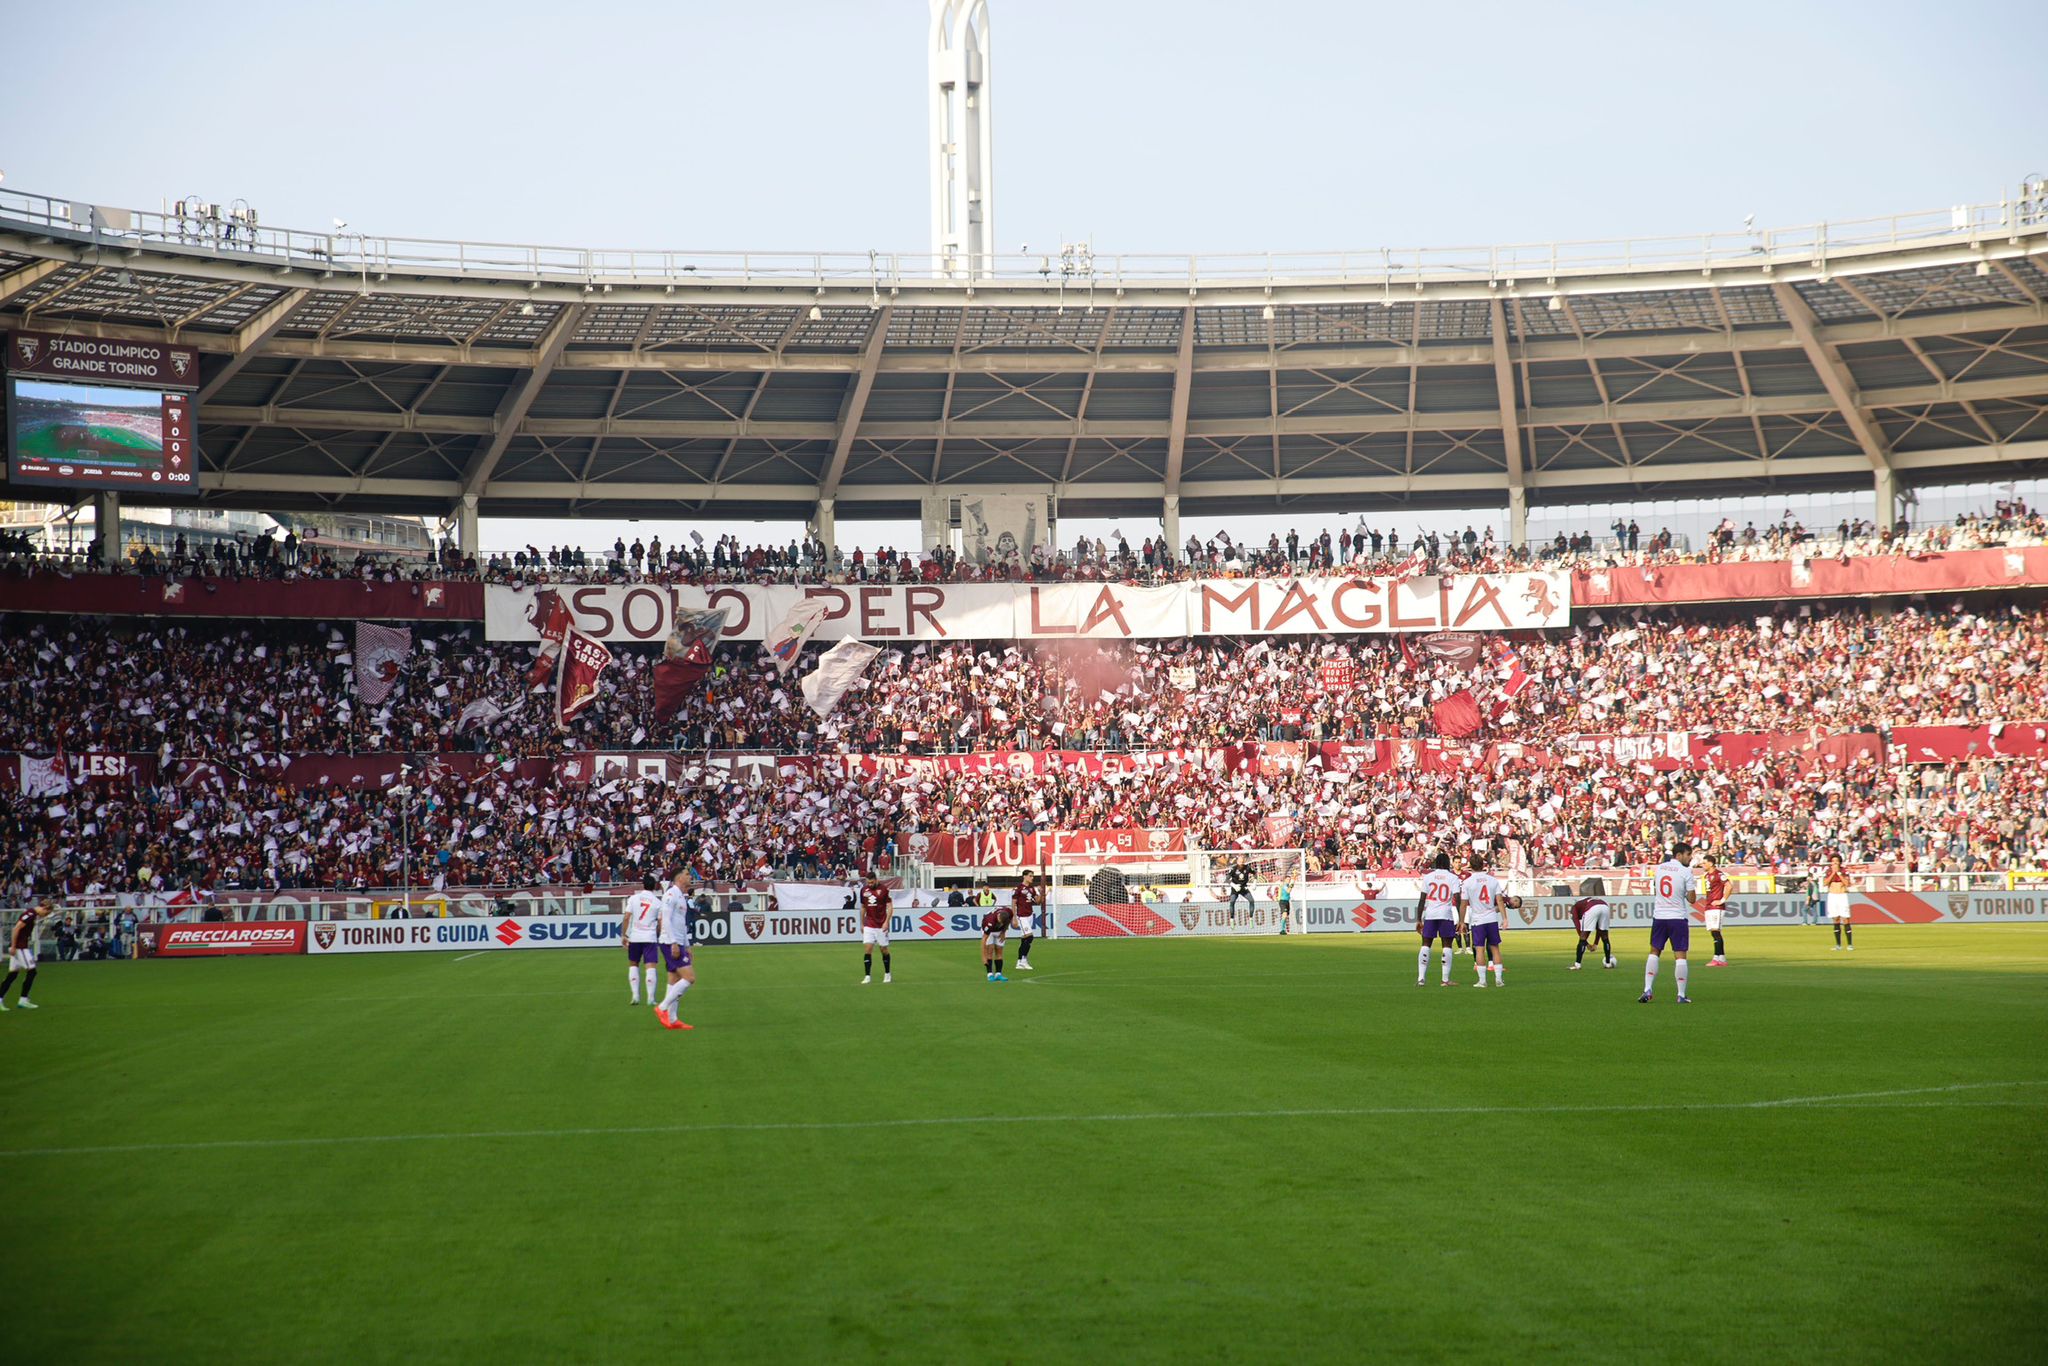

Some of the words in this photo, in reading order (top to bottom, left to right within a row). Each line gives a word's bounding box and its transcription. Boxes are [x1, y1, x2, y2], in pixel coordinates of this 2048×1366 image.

[50, 339, 97, 354] STADIO
[99, 344, 160, 360] OLIMPICO
[53, 357, 106, 372] GRANDE
[108, 362, 157, 376] TORINO
[172, 427, 179, 436] 0
[172, 442, 179, 451] 0
[168, 472, 190, 481] 0:00
[804, 587, 947, 637] PER
[1030, 584, 1132, 637] LA
[1200, 576, 1513, 633] MAGLIA
[953, 832, 1023, 867] CIAO
[1427, 882, 1450, 902] 20
[1478, 884, 1490, 904] 4
[1660, 875, 1673, 898] 6
[639, 903, 651, 920] 7
[1974, 898, 2034, 915] TORINO
[2041, 898, 2048, 914] F
[342, 927, 404, 945] TORINO
[411, 926, 431, 943] FC
[437, 924, 489, 942] GUIDA
[528, 922, 623, 940] SUZUK
[770, 917, 831, 935] TORINO
[838, 916, 857, 934] FC
[169, 929, 295, 942] FRECCIAROSSA
